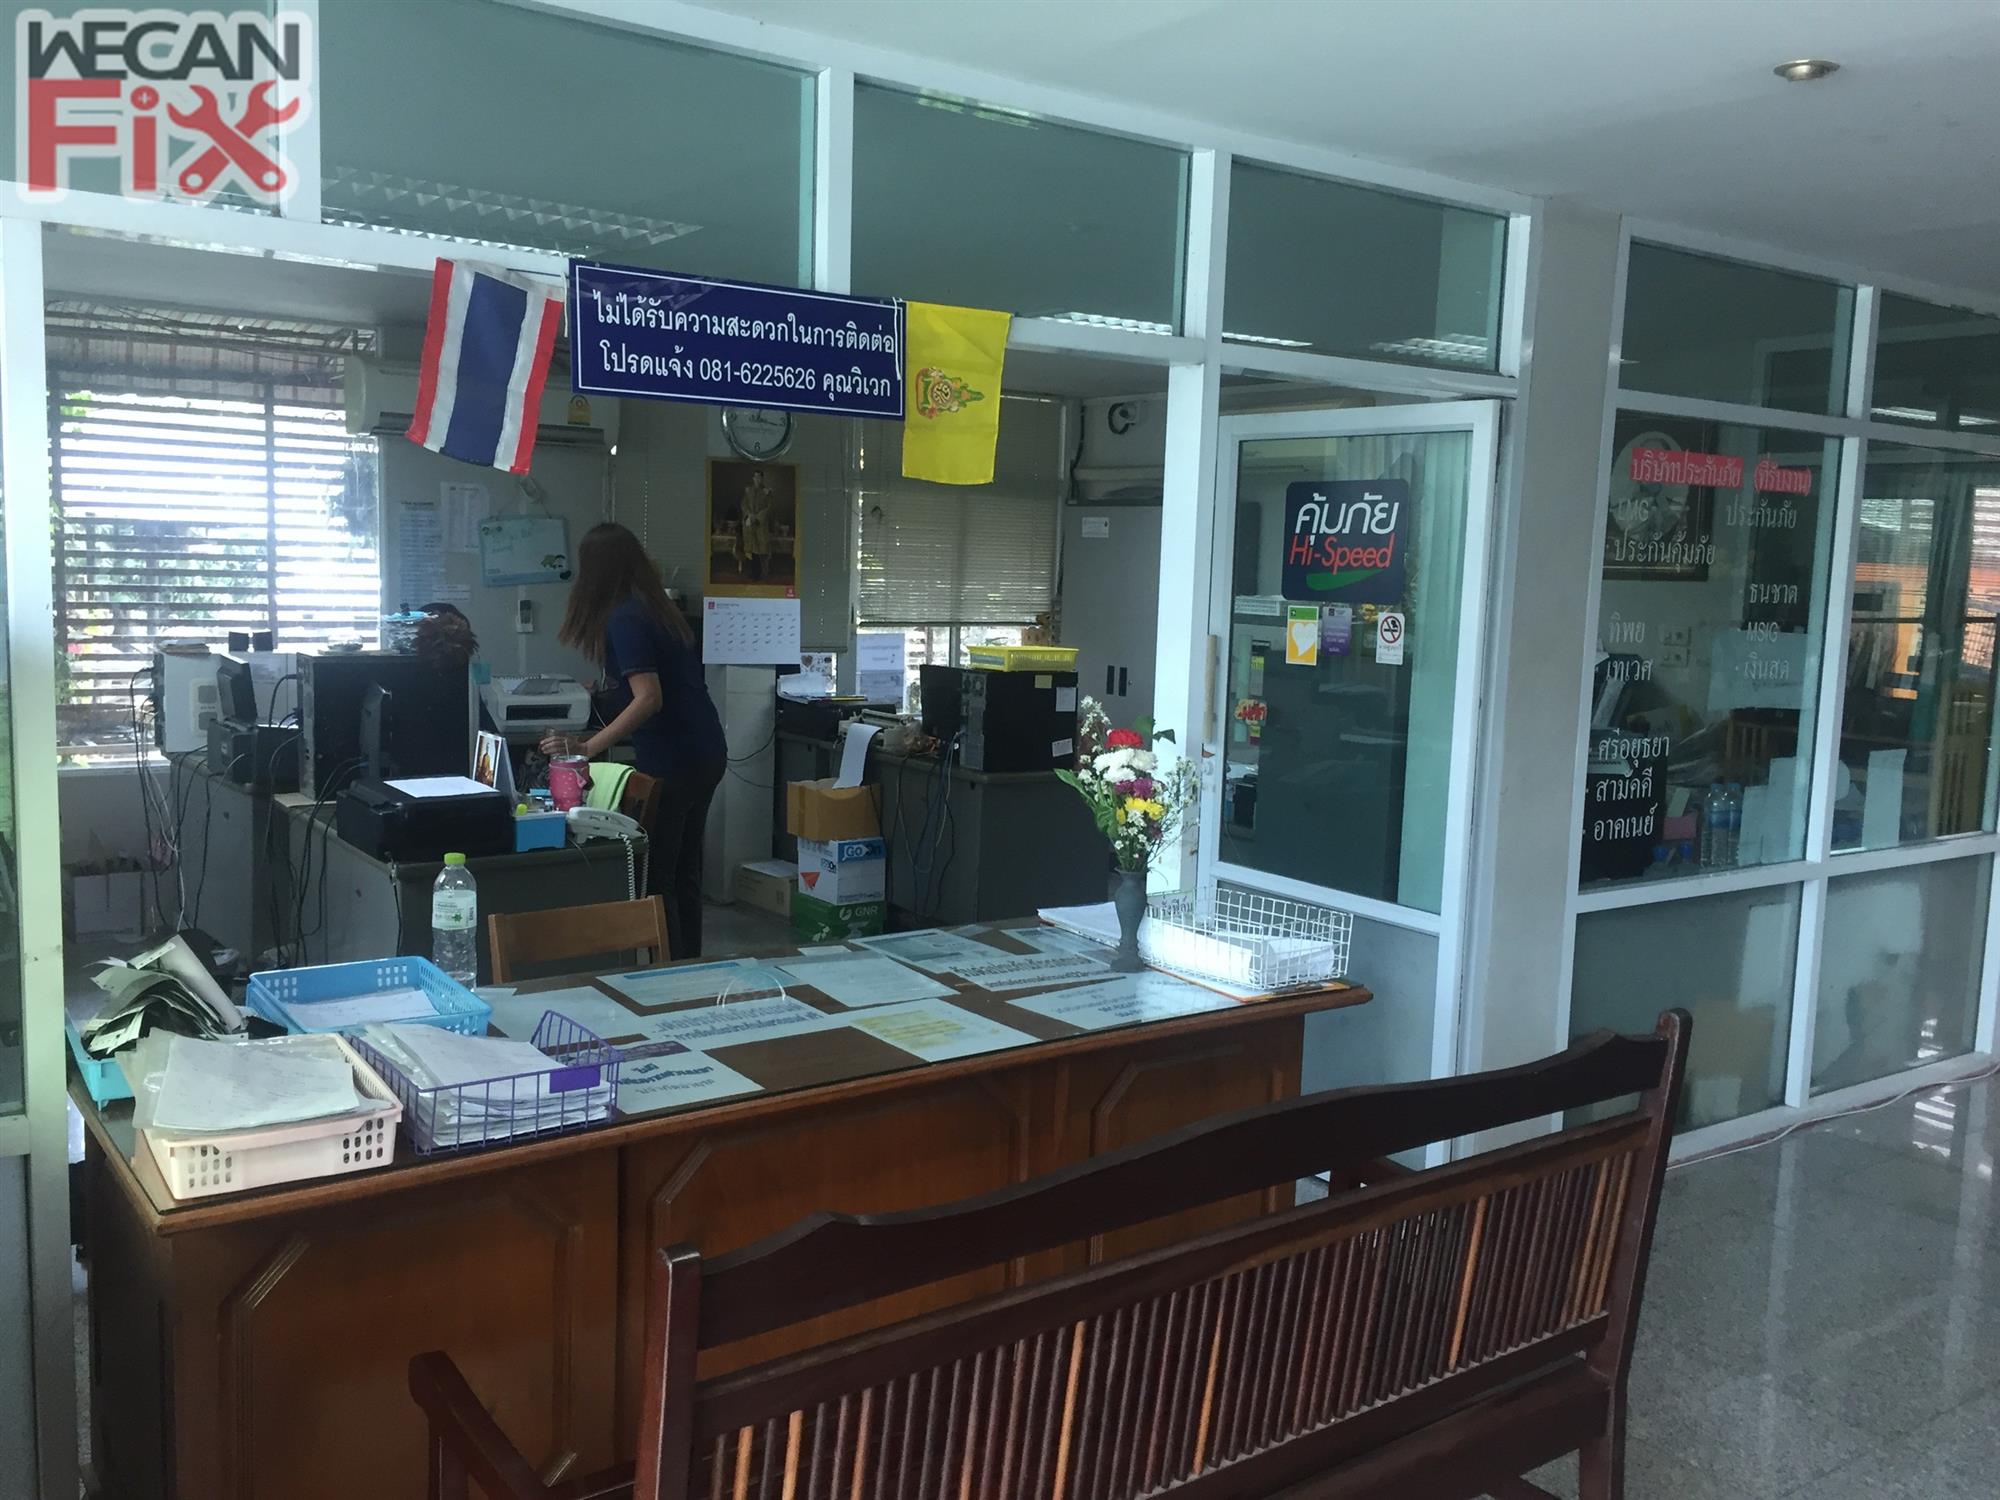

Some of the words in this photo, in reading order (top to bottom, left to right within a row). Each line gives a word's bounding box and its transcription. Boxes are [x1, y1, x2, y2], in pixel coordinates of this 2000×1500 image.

[593, 289, 895, 354] ไม่ได้รับความสะดวกในการติดต่อ
[599, 339, 693, 379] โปรดแจ้ง
[700, 358, 816, 390] 081-6225626
[823, 367, 890, 401] คุณวิเวก
[1632, 450, 1741, 487] บริษัทประกันภัย
[1295, 492, 1400, 545] คุ้มภัย
[1725, 493, 1797, 529] ประกันภัย
[1289, 533, 1395, 575] Hi-Speed
[1614, 526, 1717, 574] ประกันคุ้มภัย
[1746, 621, 1779, 642] MSIG
[1596, 767, 1653, 802] สามัคคี
[1594, 803, 1658, 841] อาคเนย์
